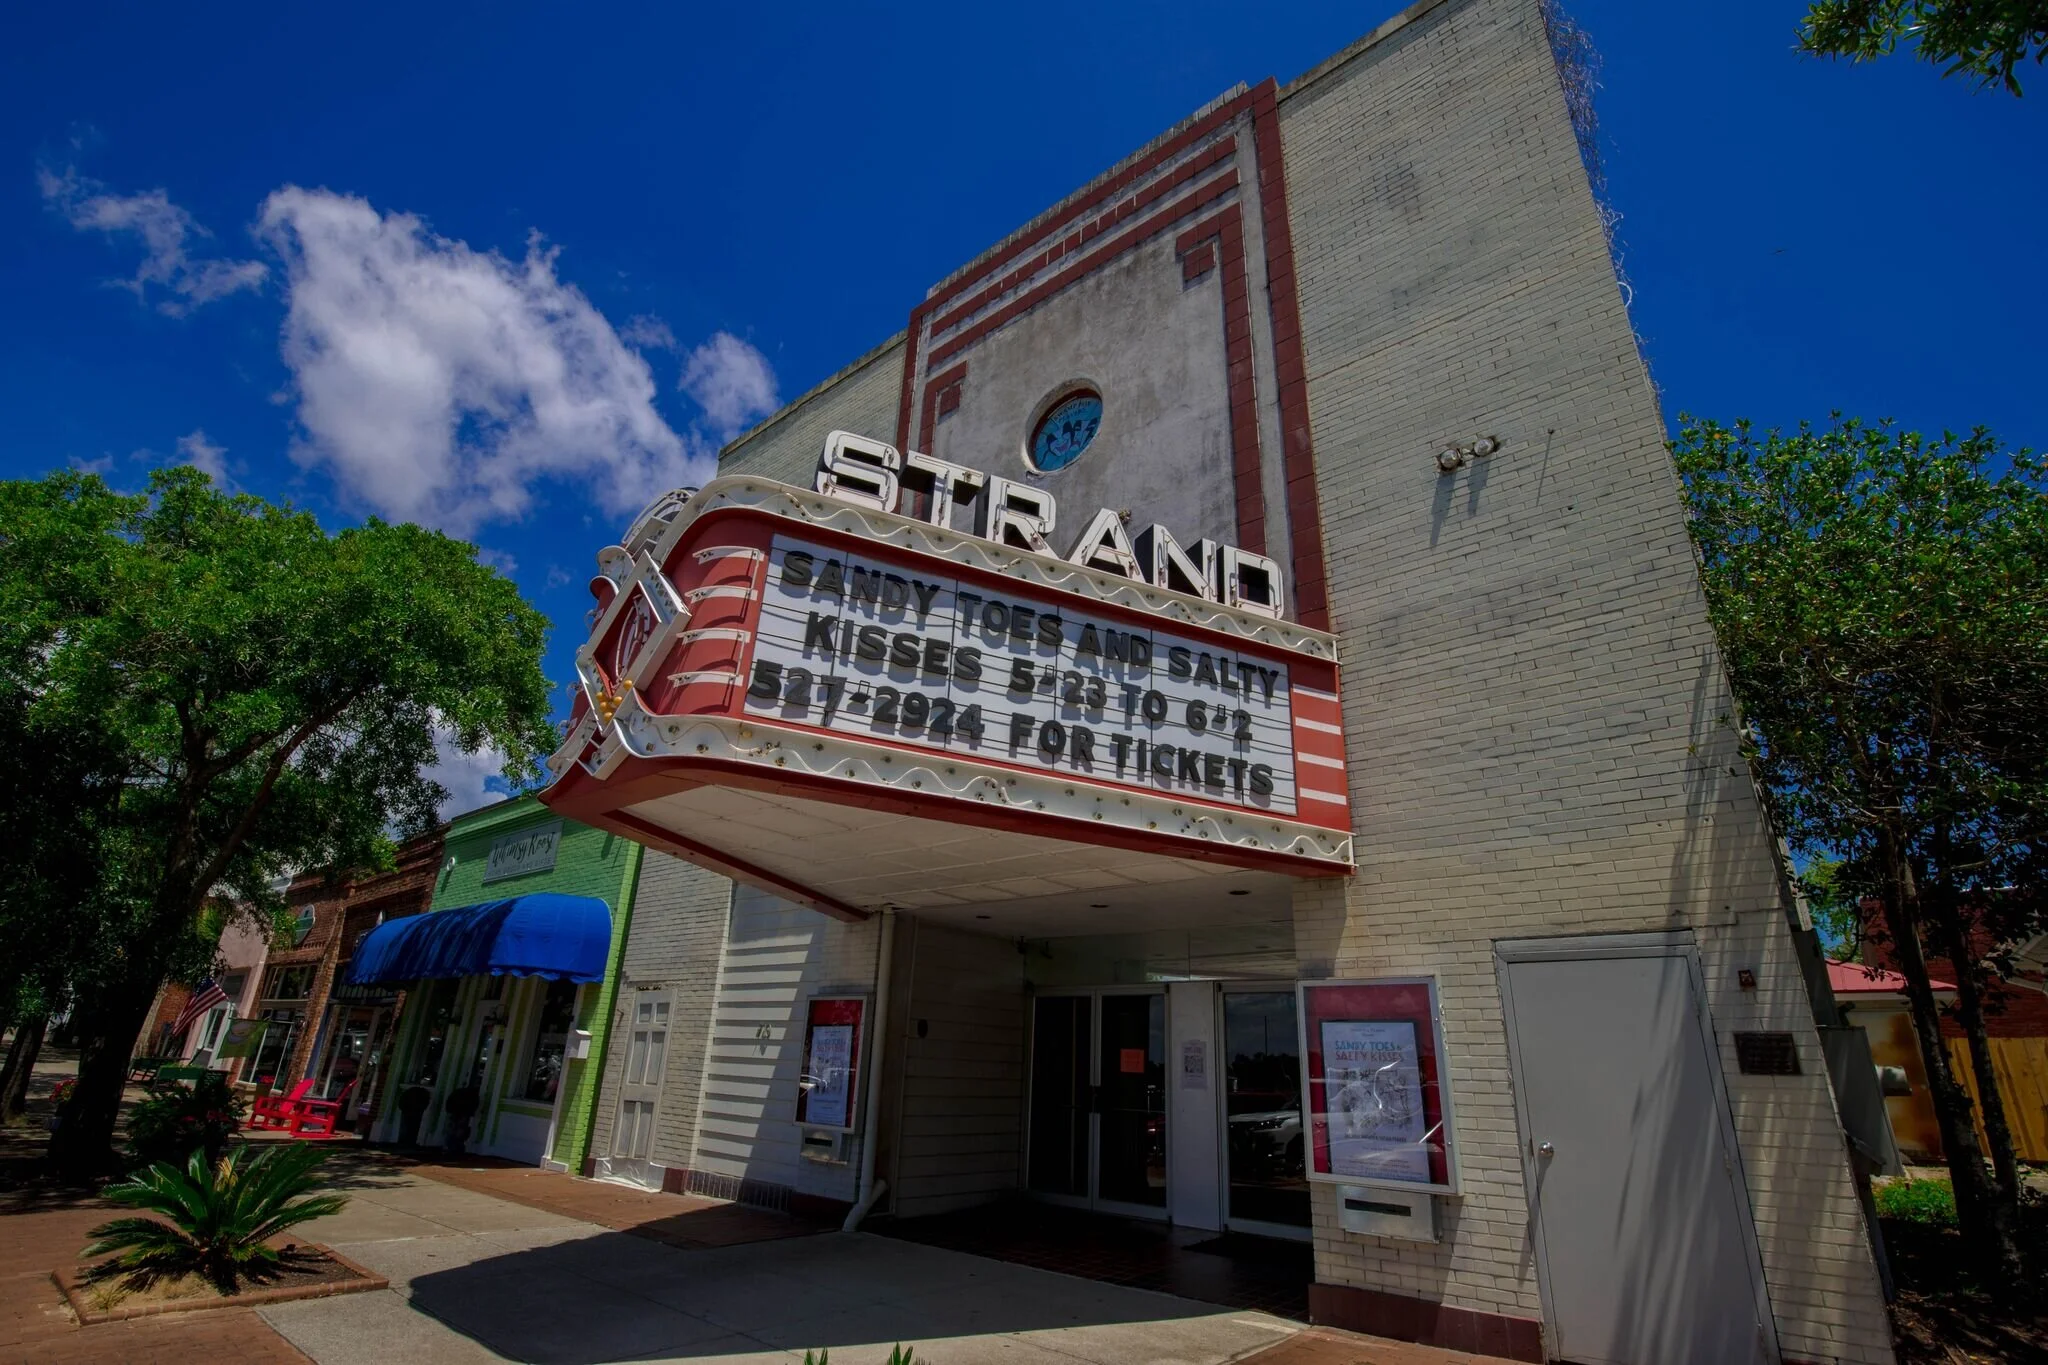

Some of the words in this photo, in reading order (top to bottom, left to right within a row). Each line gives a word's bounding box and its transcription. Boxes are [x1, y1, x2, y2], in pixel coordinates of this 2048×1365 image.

[816, 430, 1284, 621] STRAND
[782, 550, 941, 616] SANDY
[958, 591, 1064, 646] TOES
[1077, 622, 1151, 667] AND
[1168, 646, 1279, 698] SALTY
[805, 611, 983, 681] KISSES
[1009, 657, 1107, 709] 5-23
[1121, 683, 1168, 722] TO
[1186, 699, 1252, 741] 6-2
[747, 658, 986, 740] 527-2924
[1010, 712, 1096, 762] FOR
[1111, 732, 1275, 796] TICKETS
[1370, 1041, 1395, 1051] TOES
